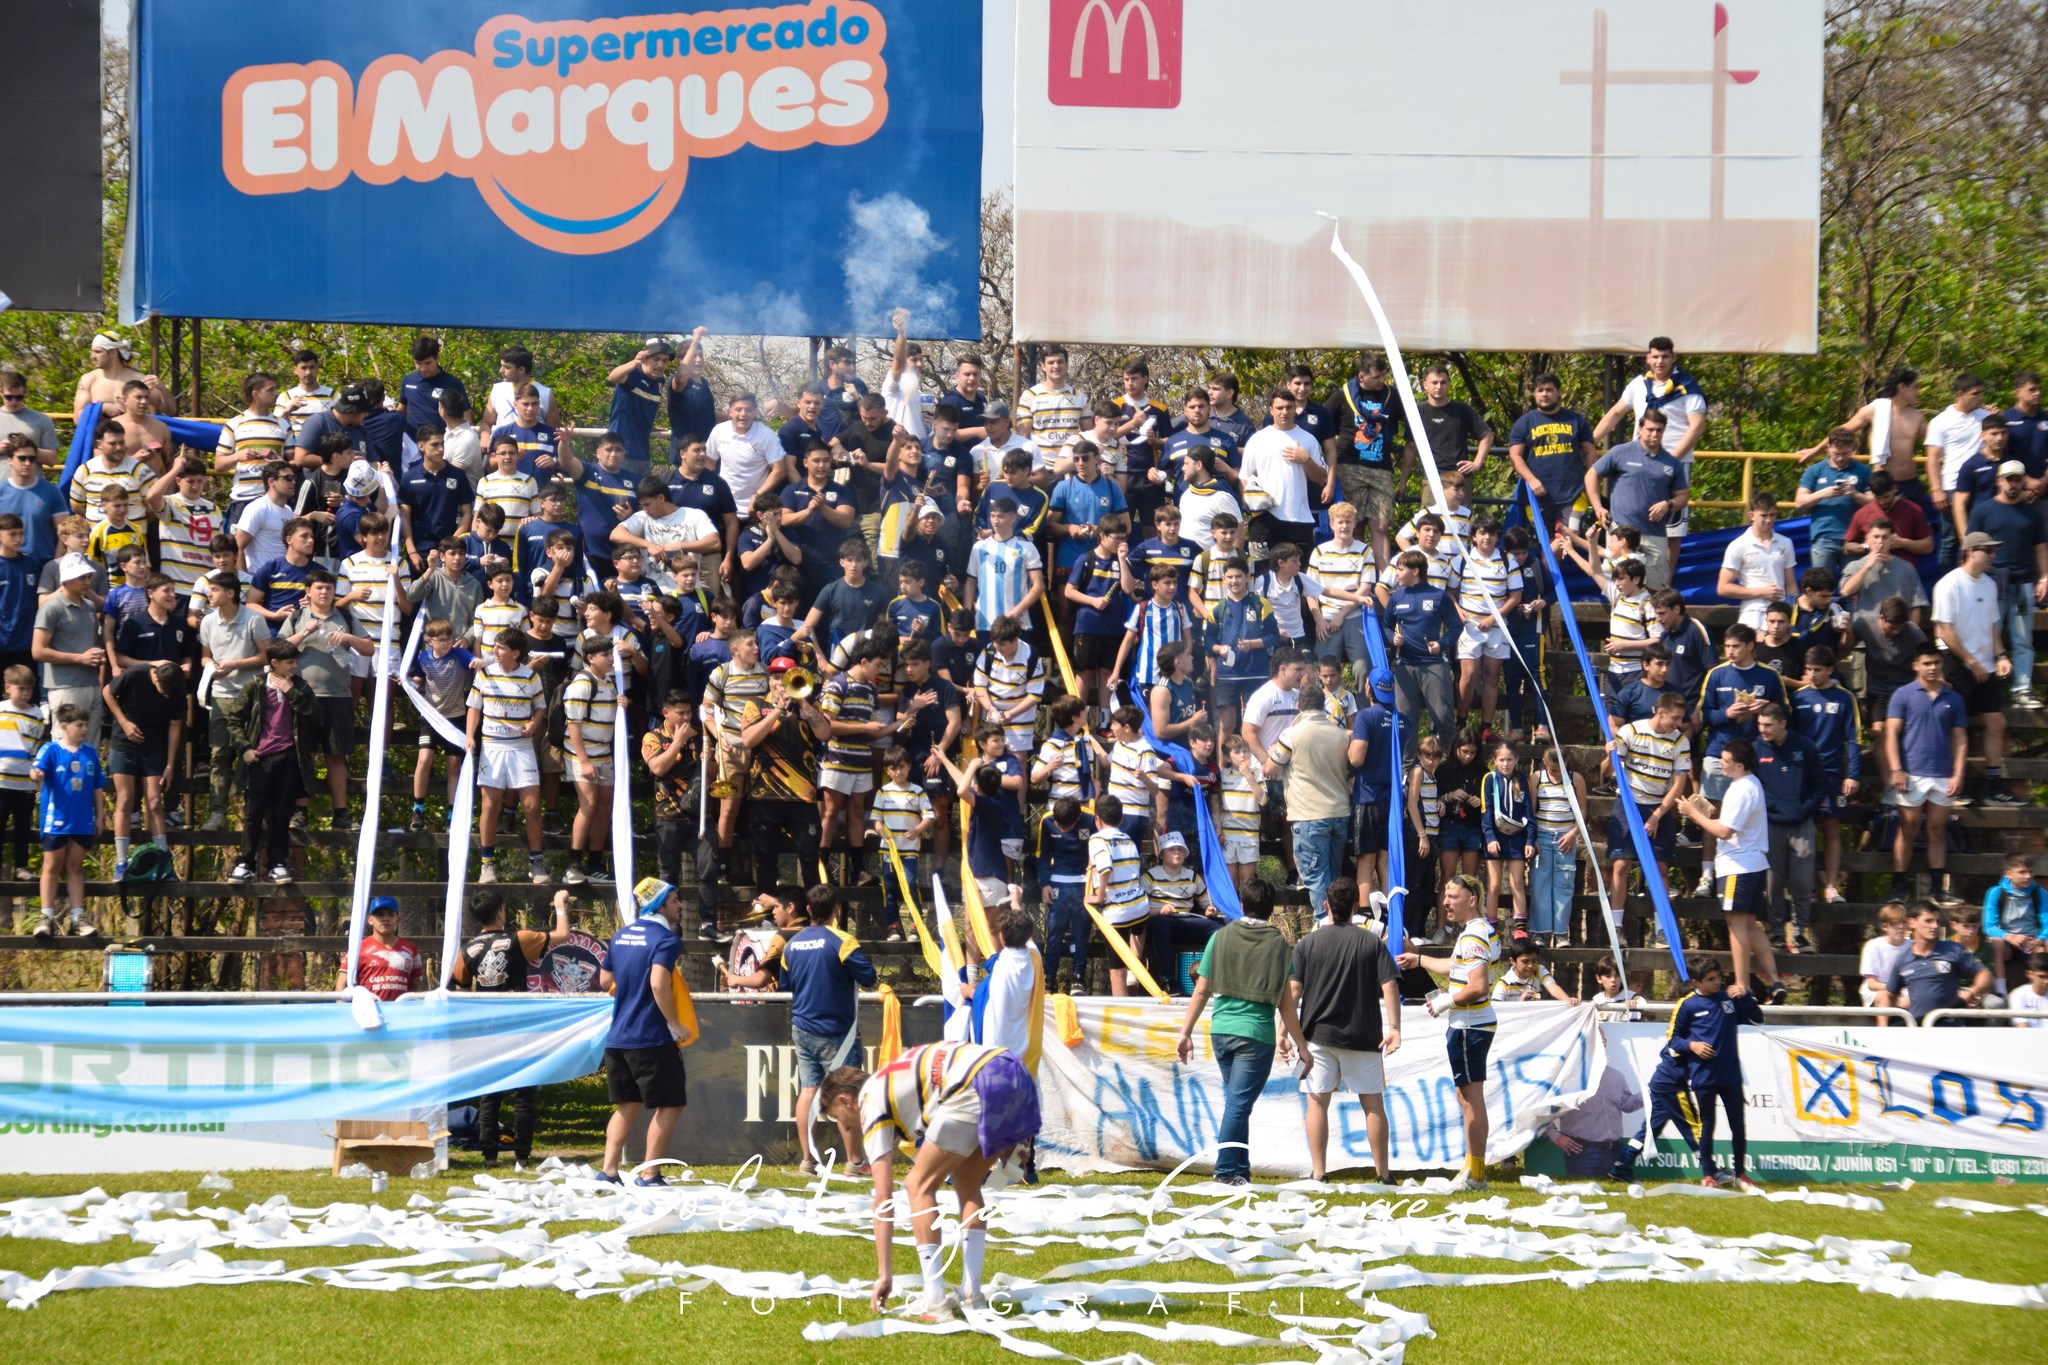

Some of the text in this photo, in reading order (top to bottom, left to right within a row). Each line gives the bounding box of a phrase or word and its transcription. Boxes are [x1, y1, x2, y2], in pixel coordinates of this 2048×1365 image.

[492, 5, 870, 77] Supermercado
[242, 60, 874, 176] El Marques
[1531, 423, 1573, 440] MICHIGAN
[1533, 442, 1574, 457] VOLLEYBALL
[994, 561, 1006, 574] 10
[790, 938, 826, 951] PROCER
[370, 975, 385, 984] CAJA
[1657, 1152, 1690, 1169] SOLA
[1729, 1154, 1757, 1171] EQ.
[1760, 1154, 1822, 1172] MENDOZA
[1832, 1152, 1873, 1172] JUNÍN
[1874, 1156, 1898, 1173] 851
[1909, 1157, 1932, 1173] 10°
[1933, 1157, 1946, 1173] D
[1988, 1158, 2020, 1175] 0381
